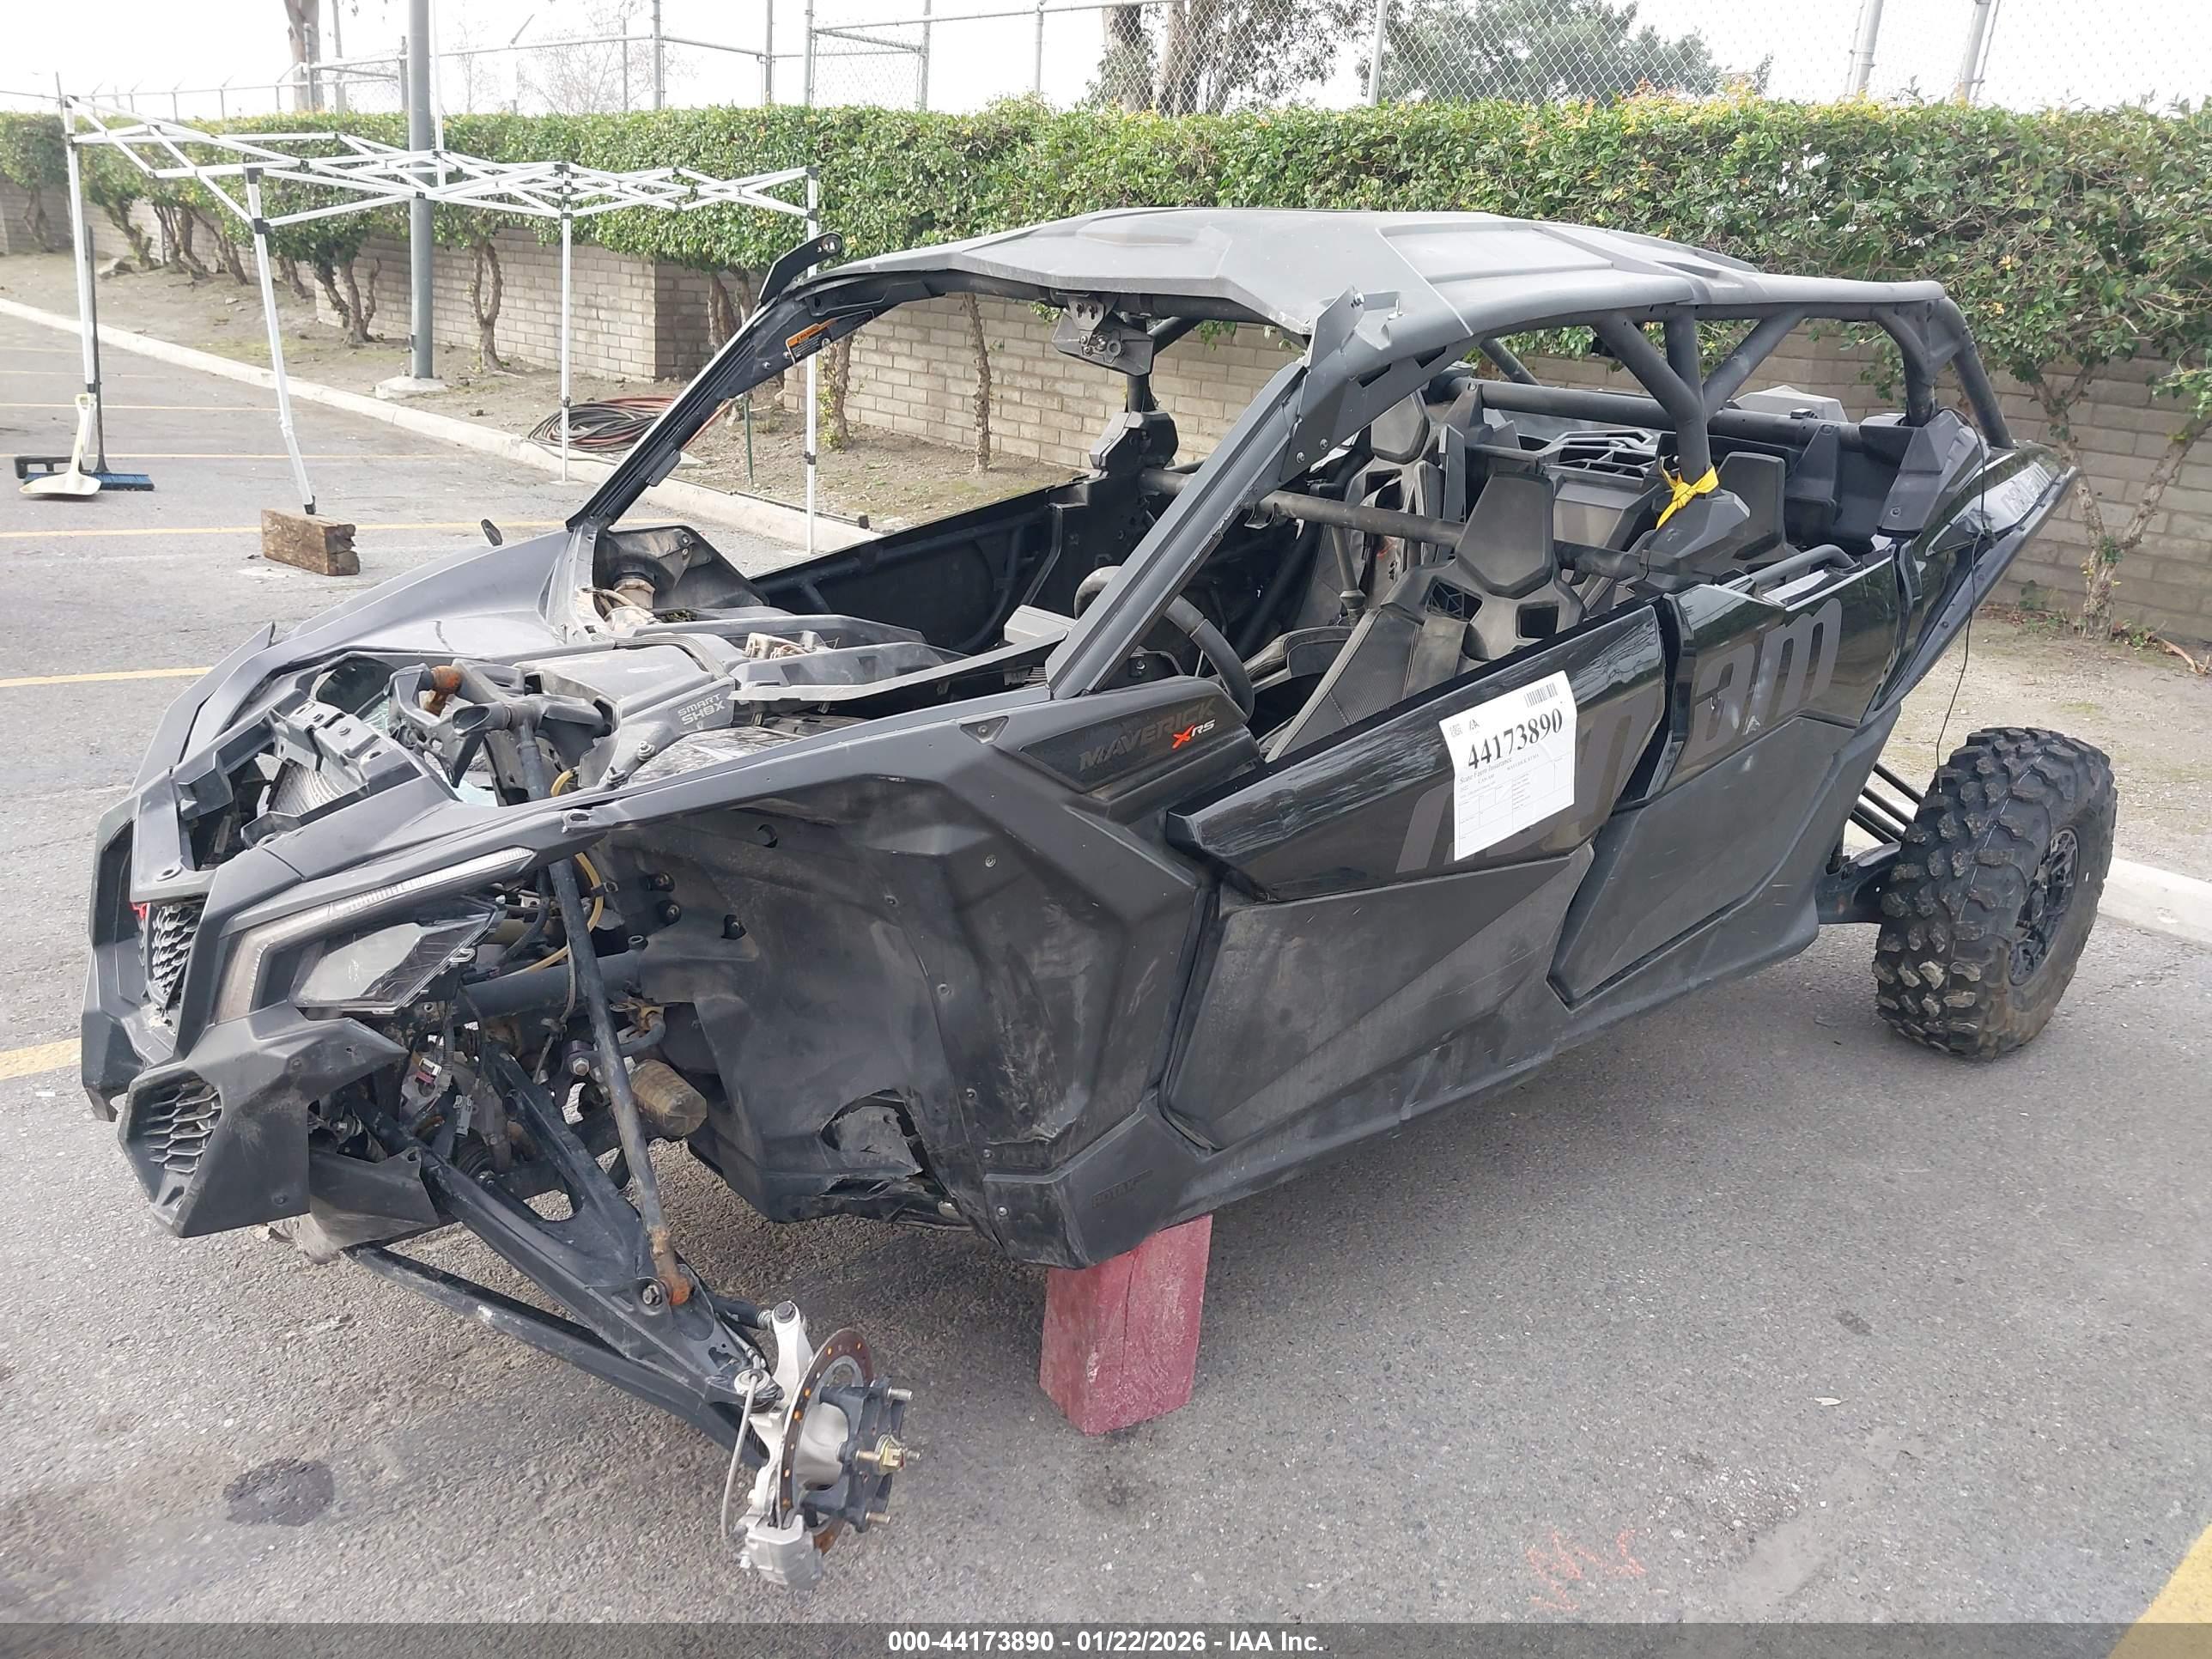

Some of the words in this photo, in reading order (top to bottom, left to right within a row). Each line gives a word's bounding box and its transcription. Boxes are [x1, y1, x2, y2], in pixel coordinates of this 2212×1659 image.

[678, 693, 720, 716] SMART
[1079, 696, 1217, 772] MAVERICK
[1468, 708, 1563, 769] 44173890
